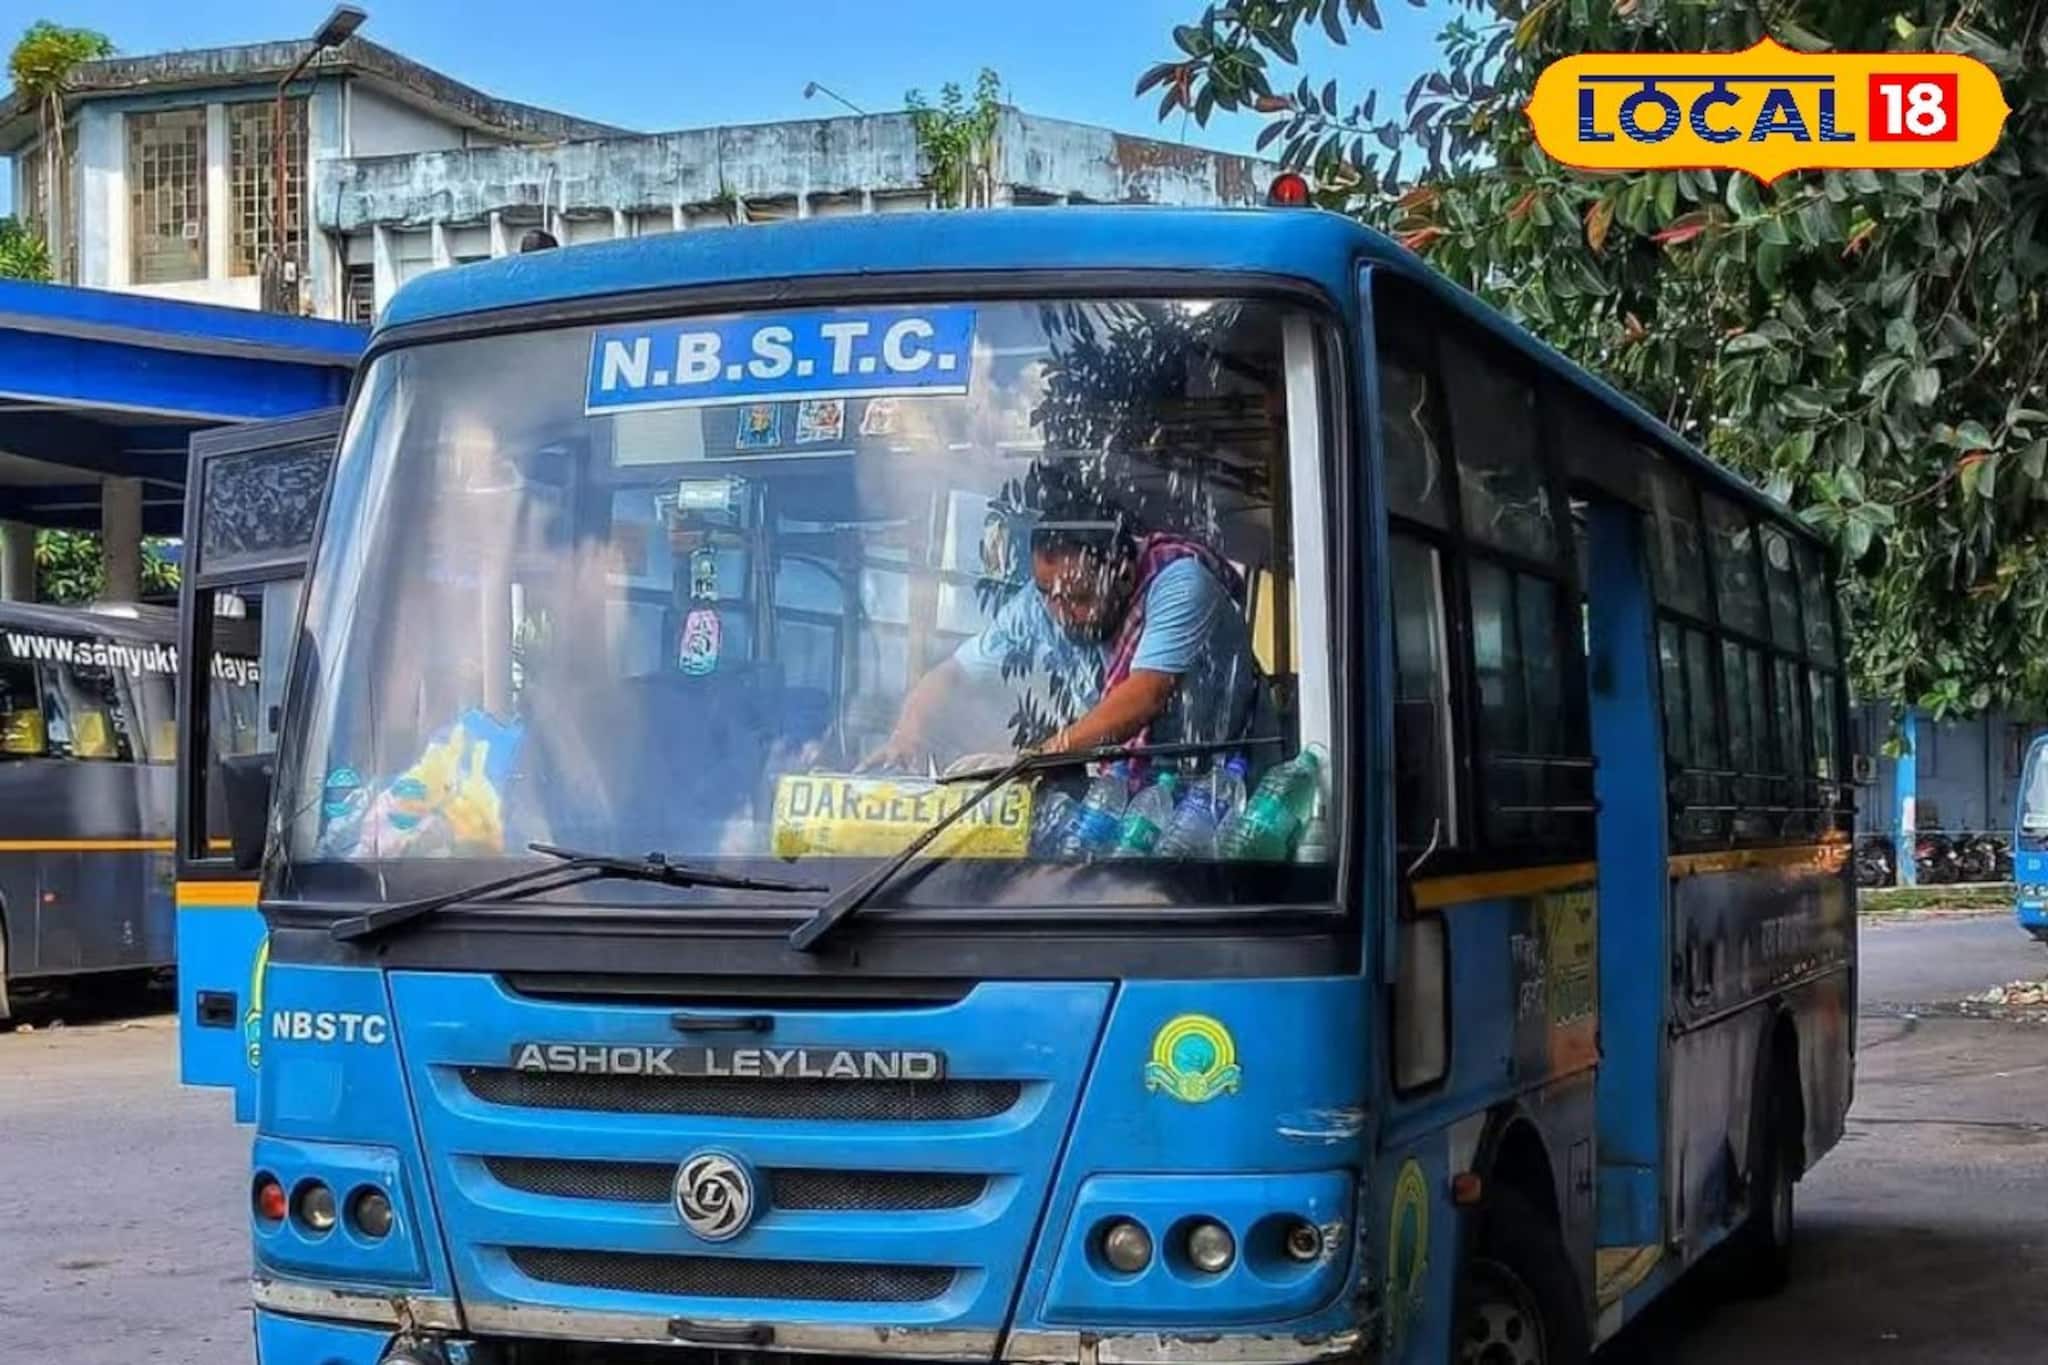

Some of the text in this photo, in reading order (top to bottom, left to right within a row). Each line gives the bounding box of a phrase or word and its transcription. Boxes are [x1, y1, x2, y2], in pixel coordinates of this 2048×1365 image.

[601, 318, 956, 392] N.B.S.T.C.
[272, 1011, 387, 1044] NBSTC
[516, 1043, 938, 1080] ASHOK LEYLAND
